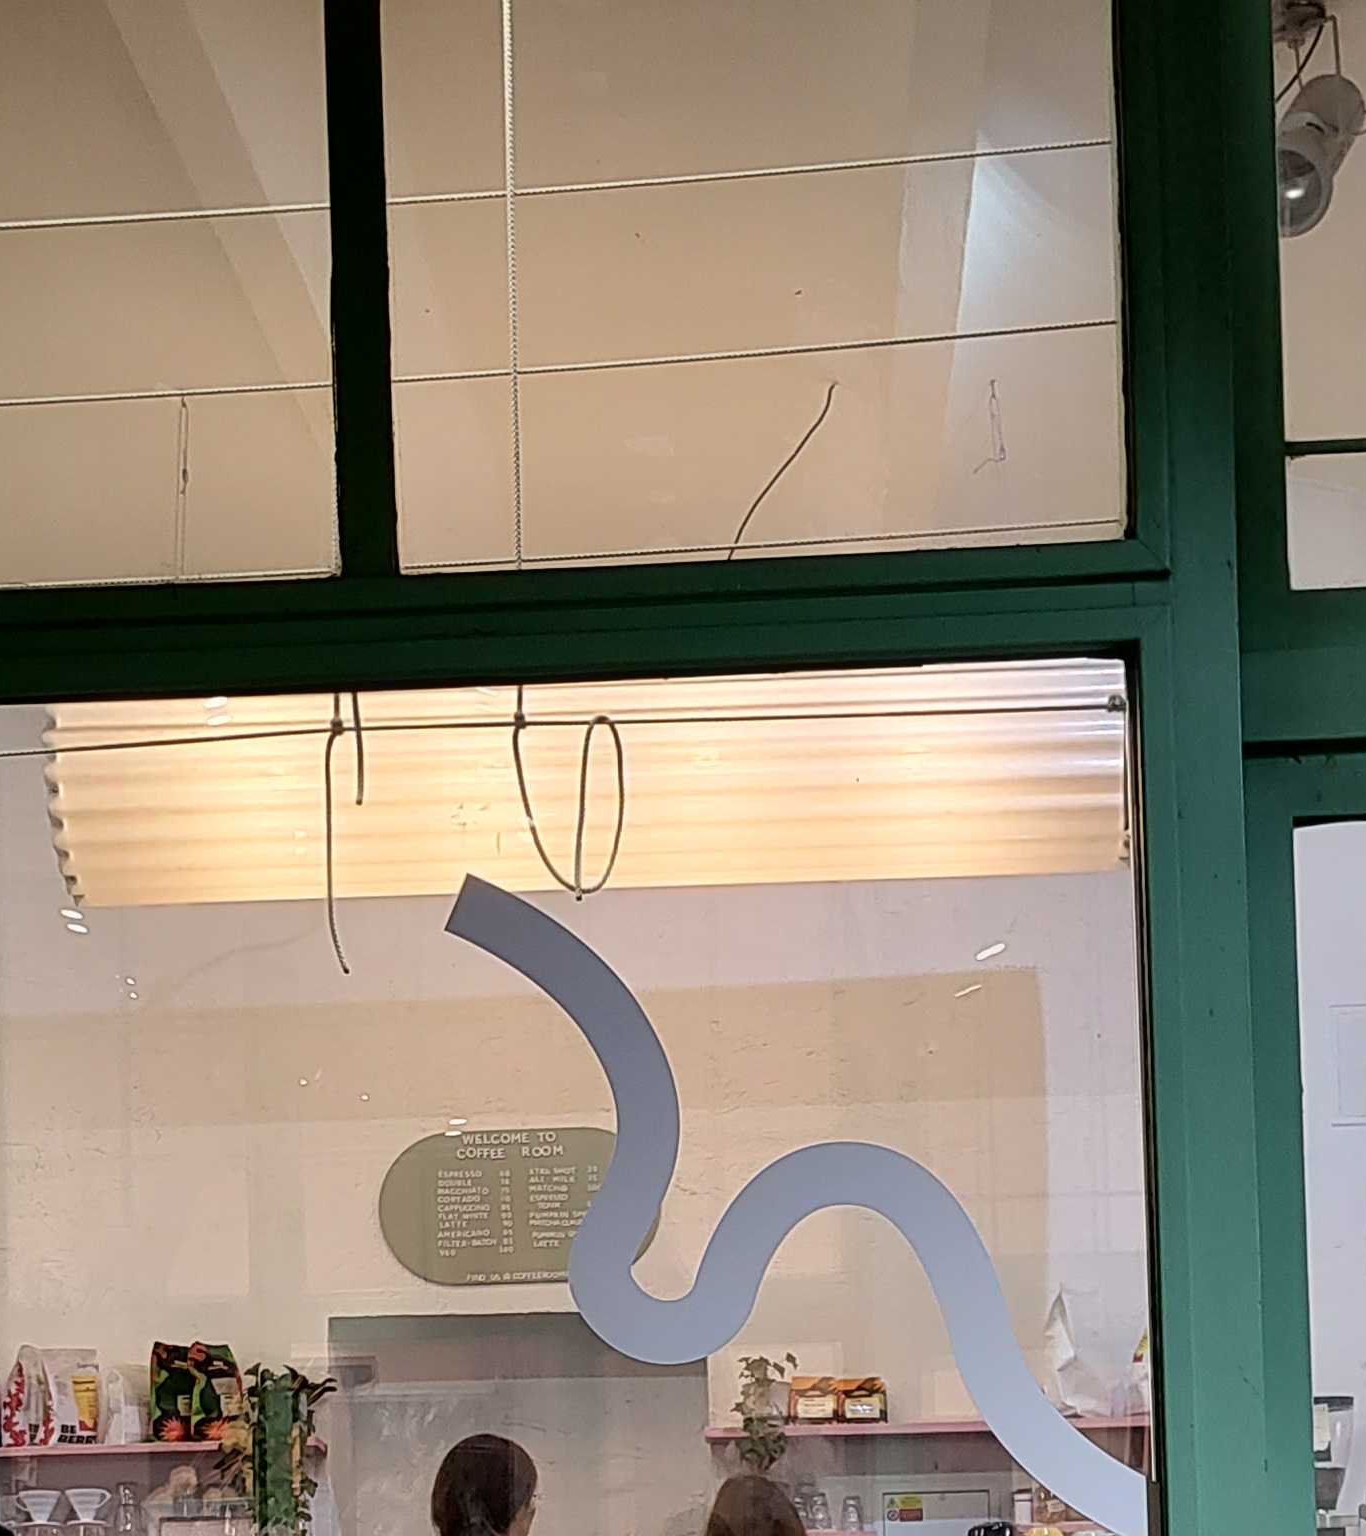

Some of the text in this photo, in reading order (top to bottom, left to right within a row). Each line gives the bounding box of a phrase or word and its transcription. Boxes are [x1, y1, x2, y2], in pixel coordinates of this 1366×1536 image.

[462, 1131, 556, 1145] WELCOME TO
[457, 1145, 564, 1159] COFFEE ROOM
[438, 1170, 482, 1178] ESPRESSO
[438, 1179, 472, 1187] DOUBLE
[529, 1176, 545, 1184] ALT
[437, 1187, 490, 1195] MACCHIATO
[437, 1195, 481, 1204] CORTADO
[529, 1193, 569, 1202] ESPRESSO
[437, 1204, 491, 1212] CAPPUCCINO
[438, 1212, 459, 1220] FLAT
[462, 1212, 489, 1220] WHITE
[439, 1221, 468, 1229] LATTE
[437, 1229, 491, 1239] AMERICANO
[533, 1240, 560, 1248] LATTE
